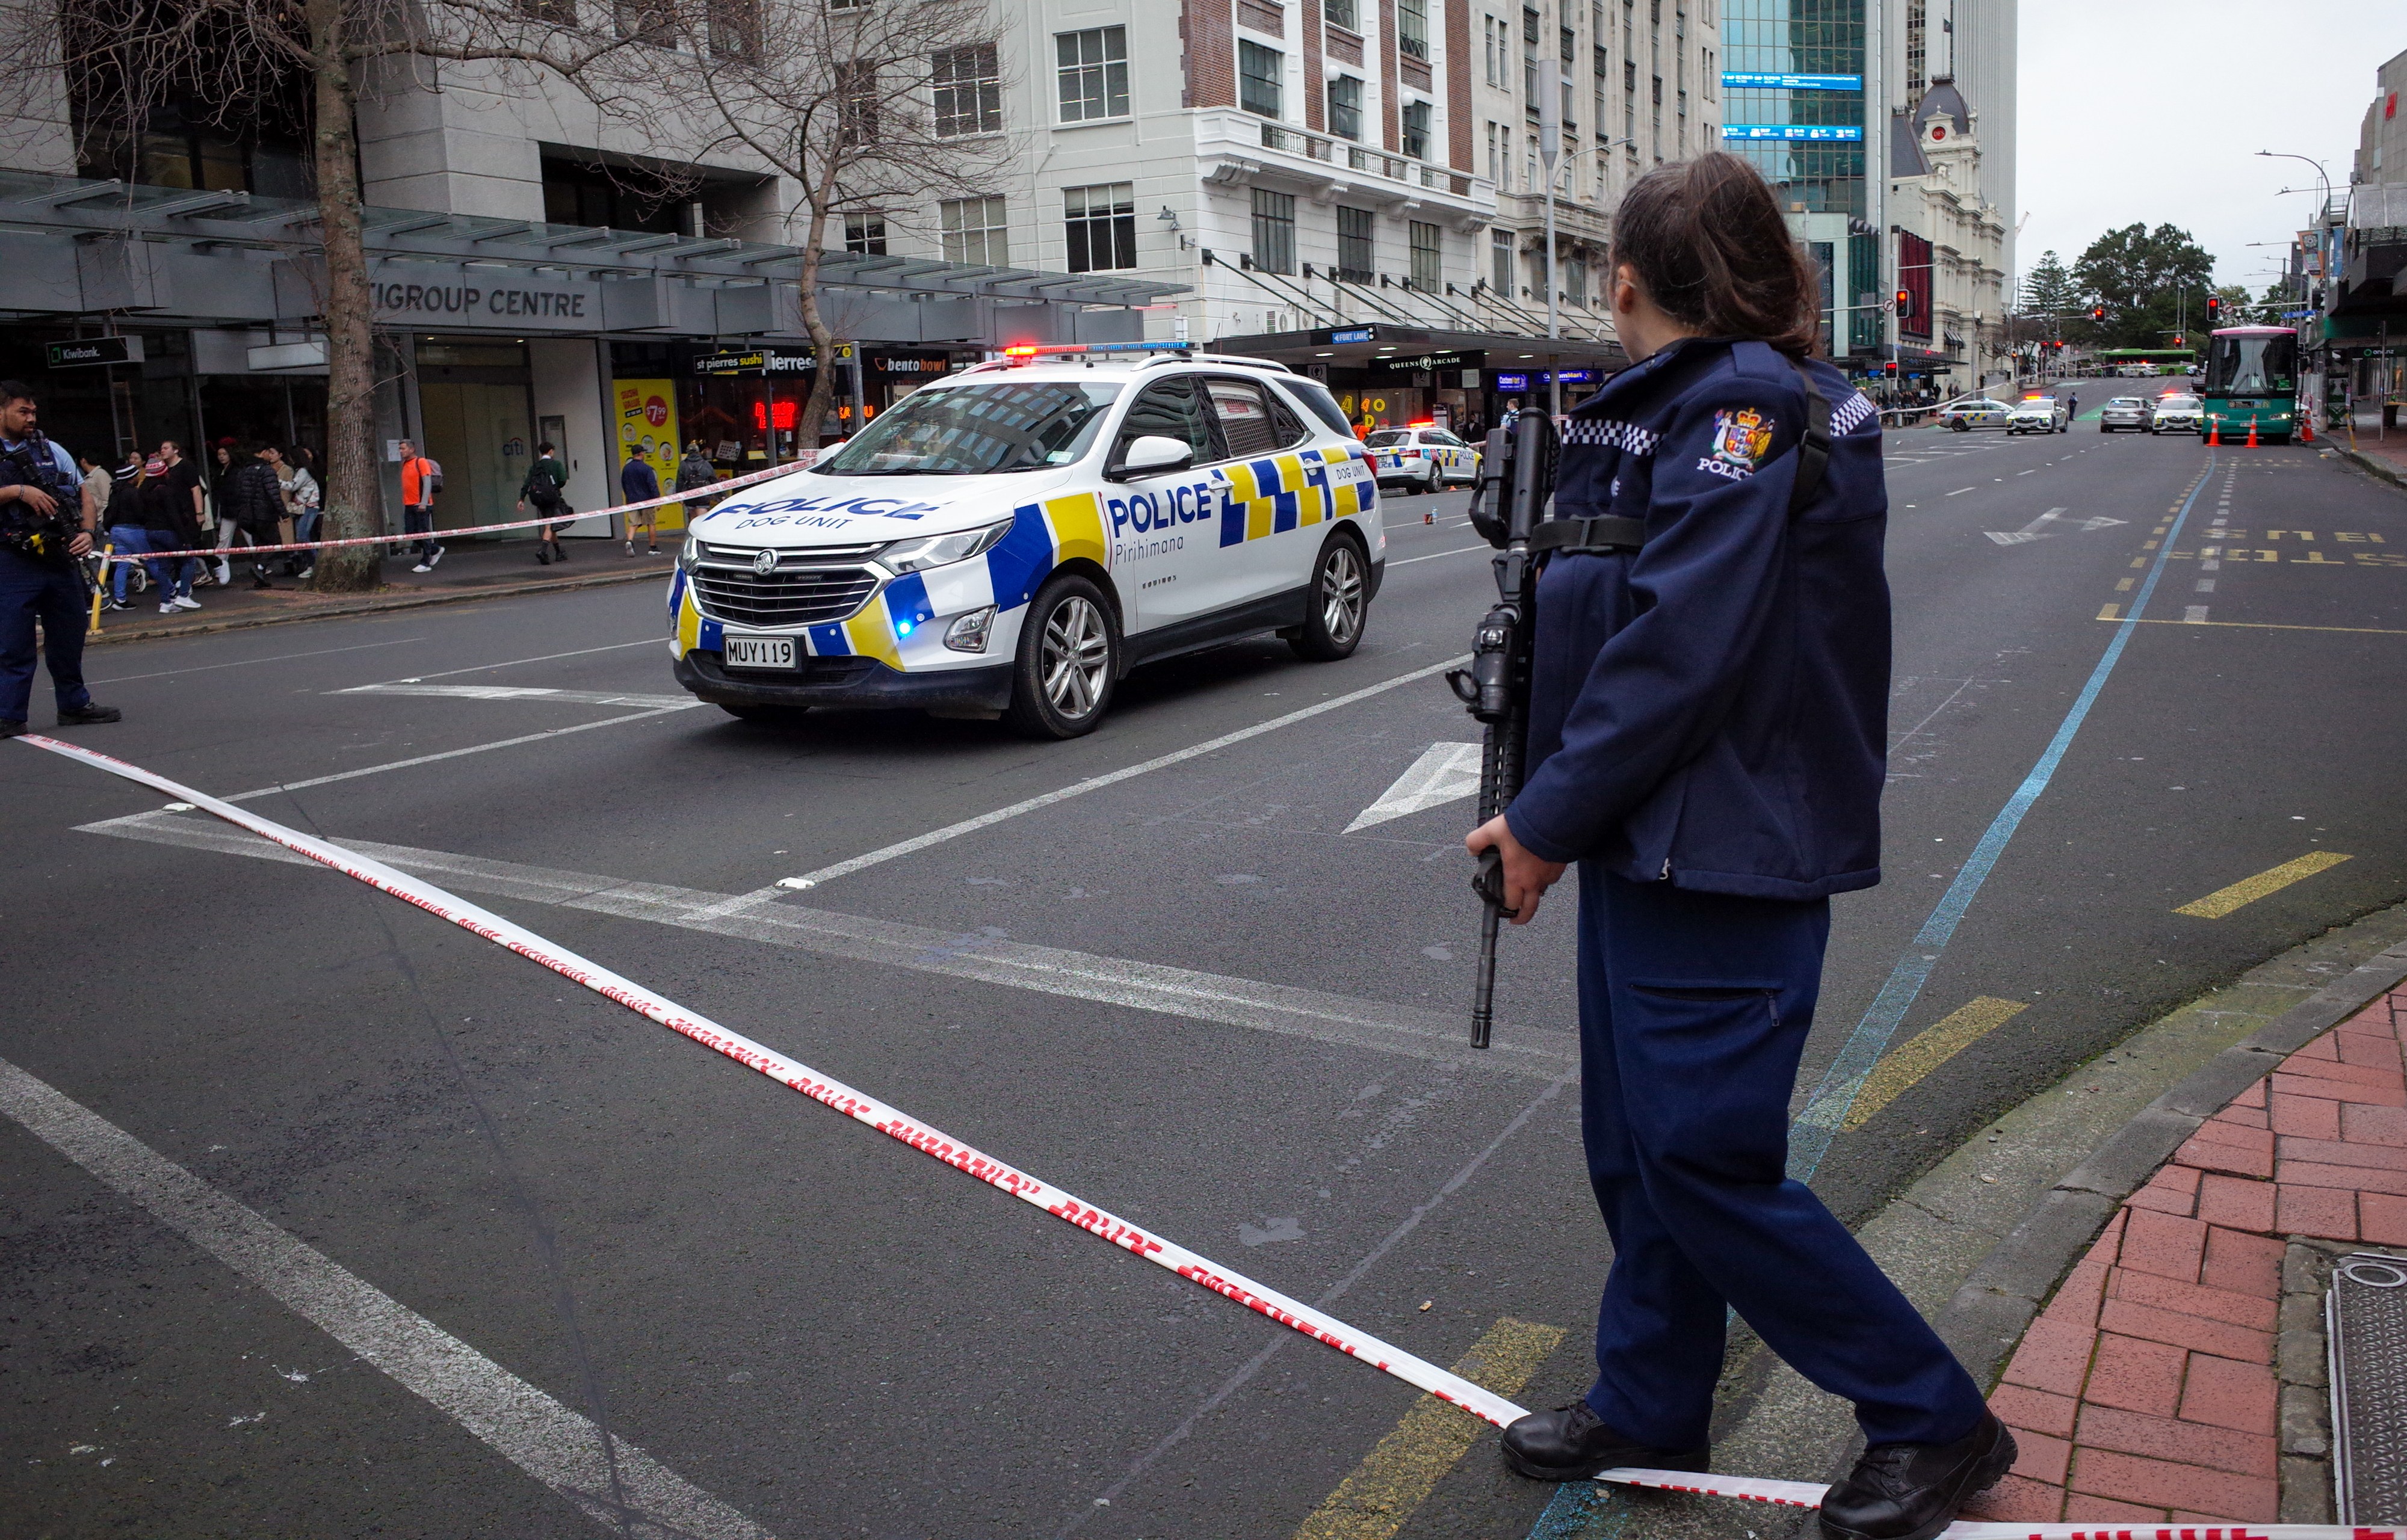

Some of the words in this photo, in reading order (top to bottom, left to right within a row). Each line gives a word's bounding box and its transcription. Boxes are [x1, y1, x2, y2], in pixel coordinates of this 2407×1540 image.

[370, 283, 480, 312] IGROUP
[489, 289, 585, 318] CENTRE
[1339, 333, 1353, 342] FORT
[1354, 331, 1368, 341] LANE
[696, 360, 705, 369] st
[706, 357, 738, 371] pierres
[740, 353, 762, 366] sushi
[1389, 361, 1419, 369] QUEENS
[1432, 357, 1461, 365] ARCADE
[646, 405, 666, 422] $7.99
[1460, 451, 1474, 460] POLICE
[1336, 467, 1352, 480] DOG
[1352, 464, 1365, 477] UNIT
[1696, 457, 1753, 481] POLIC
[703, 496, 954, 522] POLICE
[1107, 482, 1211, 538] POLICE
[734, 517, 786, 529] DOG
[794, 516, 854, 529] UNIT
[1115, 536, 1184, 565] Pirihimana
[728, 641, 791, 663] MUY119
